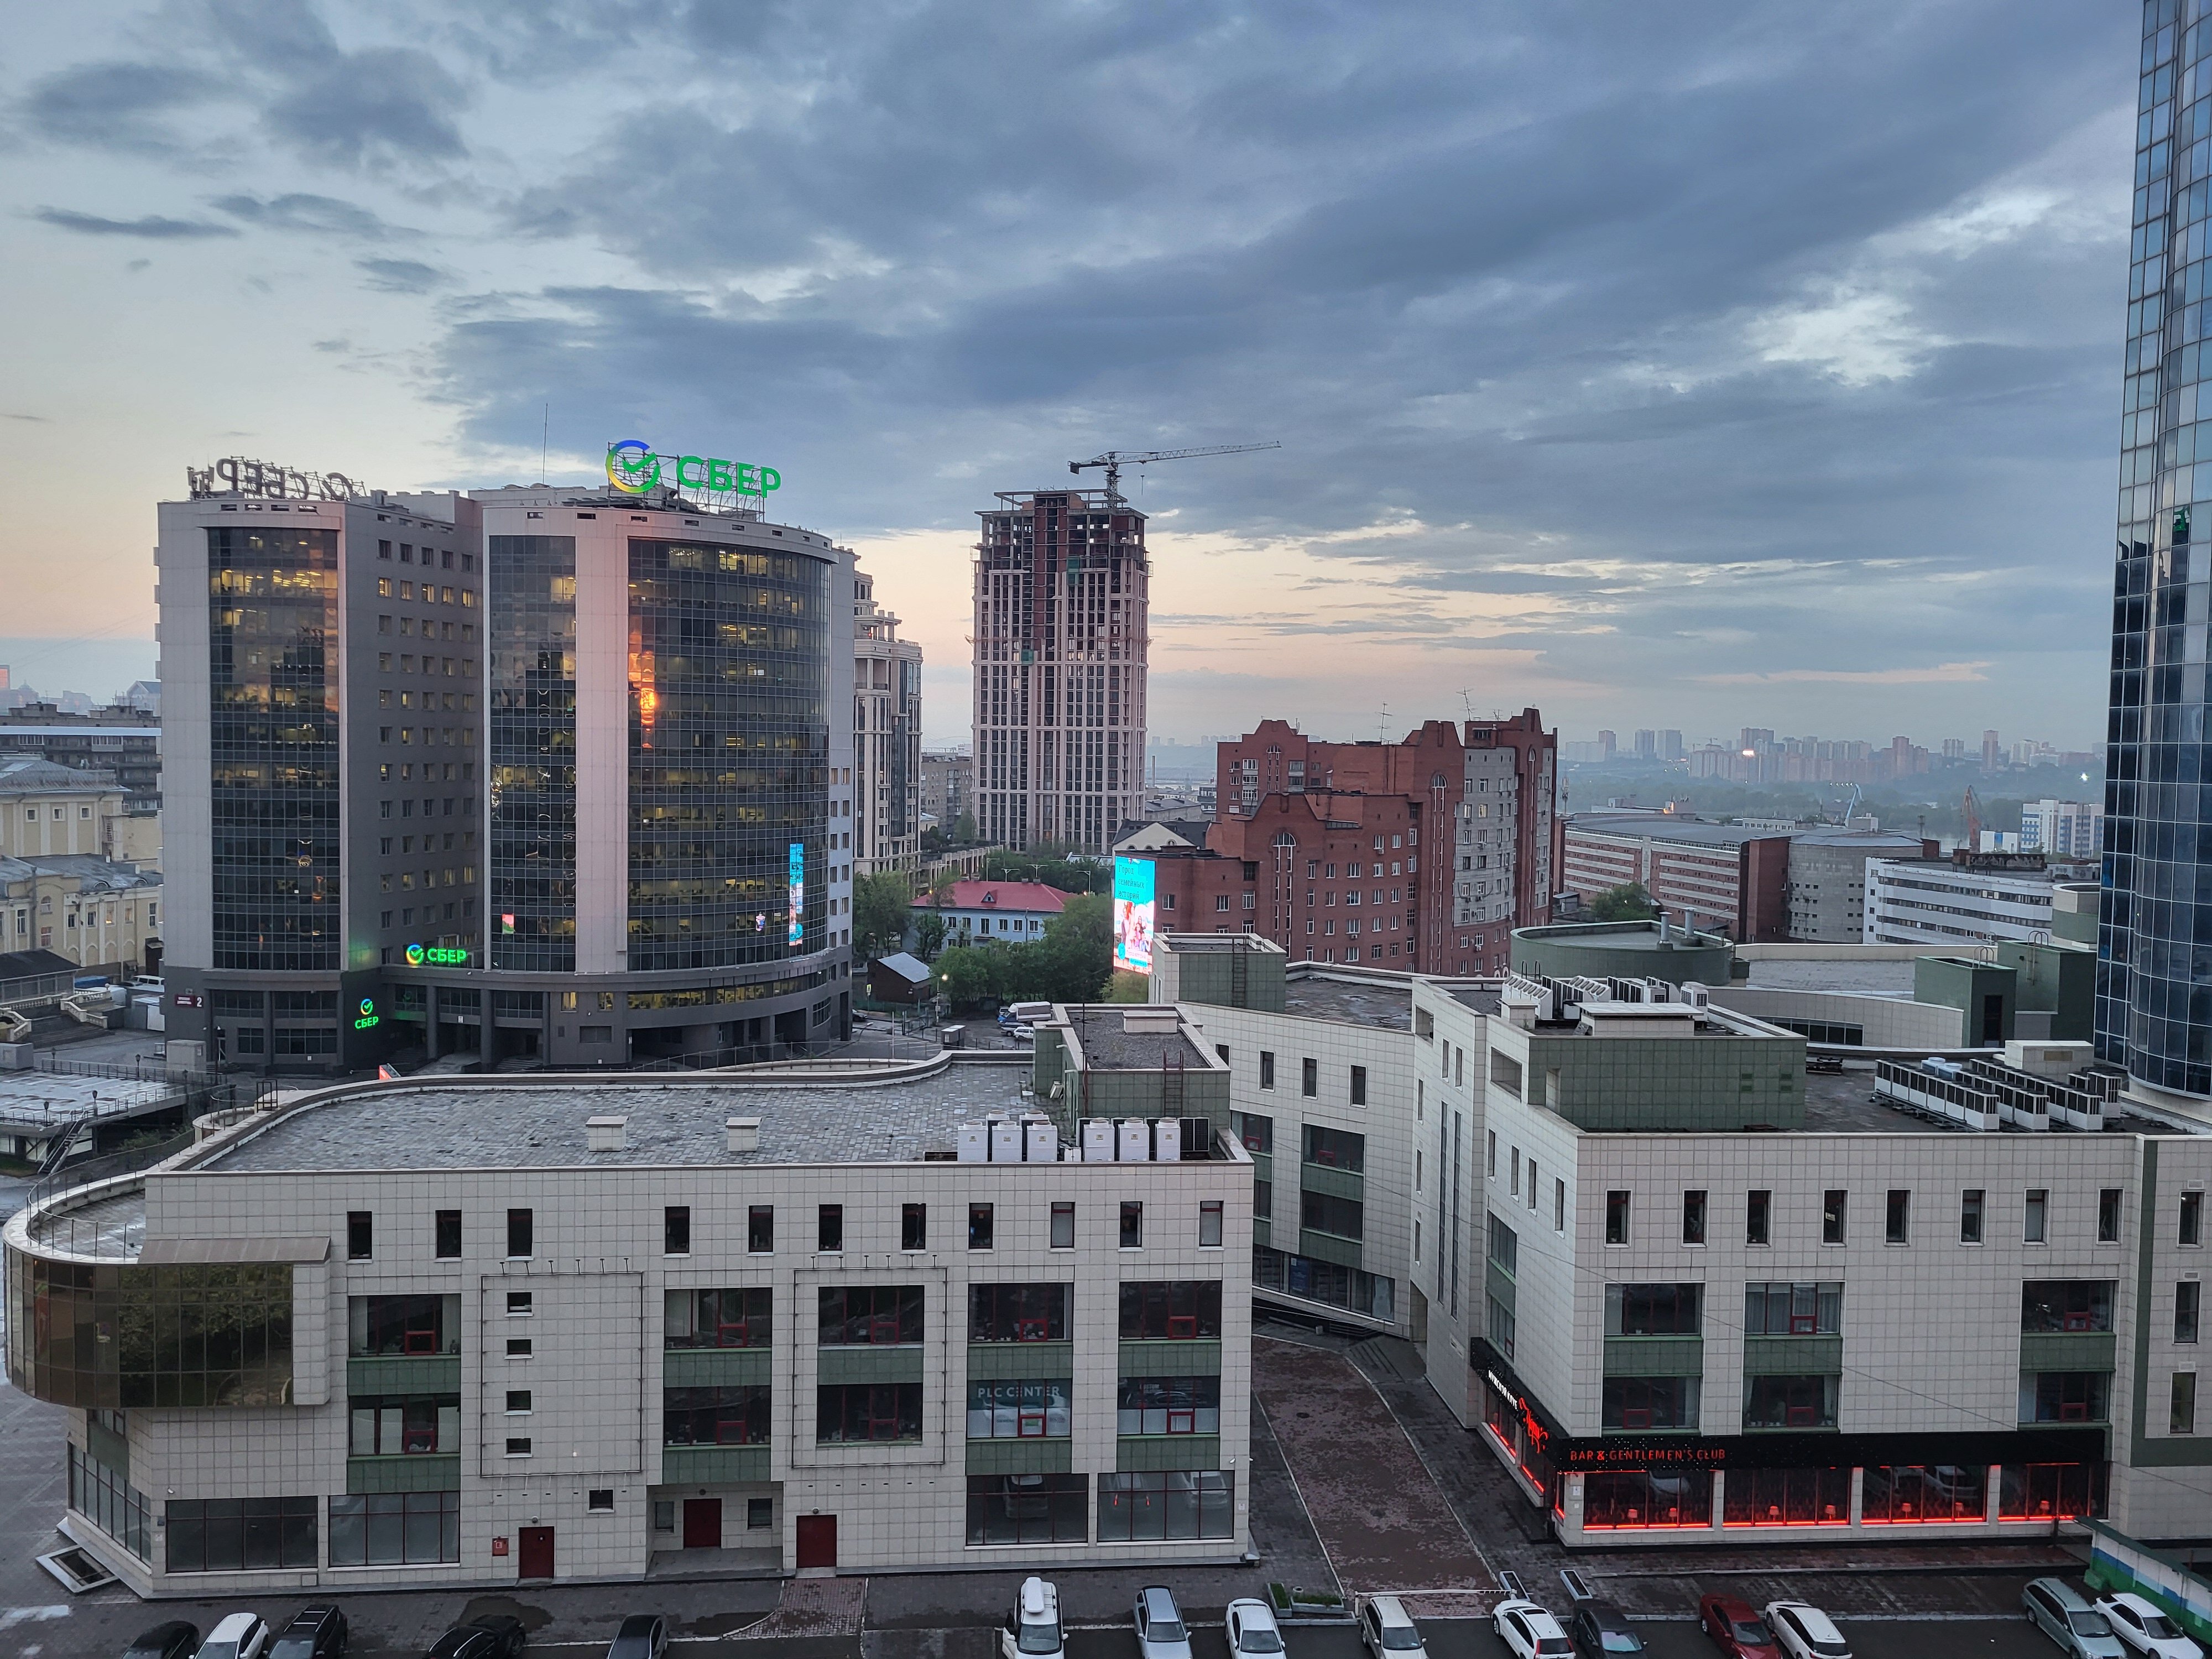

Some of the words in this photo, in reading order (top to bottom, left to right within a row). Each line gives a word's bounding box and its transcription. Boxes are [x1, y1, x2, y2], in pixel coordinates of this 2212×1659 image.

[676, 455, 781, 498] СБЕР
[1119, 864, 1134, 875] Город
[1118, 878, 1145, 889] семейных
[1118, 890, 1140, 901] историй
[427, 948, 467, 963] СБЕР
[196, 997, 202, 1007] 2
[354, 1016, 379, 1029] СБЕР
[978, 1387, 1003, 1398] PLC
[1006, 1386, 1060, 1397] CENTER
[1507, 1392, 1517, 1410] КЛУБ
[1570, 1451, 1593, 1461] BAR
[1597, 1451, 1605, 1460] &
[1609, 1449, 1693, 1460] GENTLEMEN'S
[1697, 1449, 1725, 1460] CLUB
